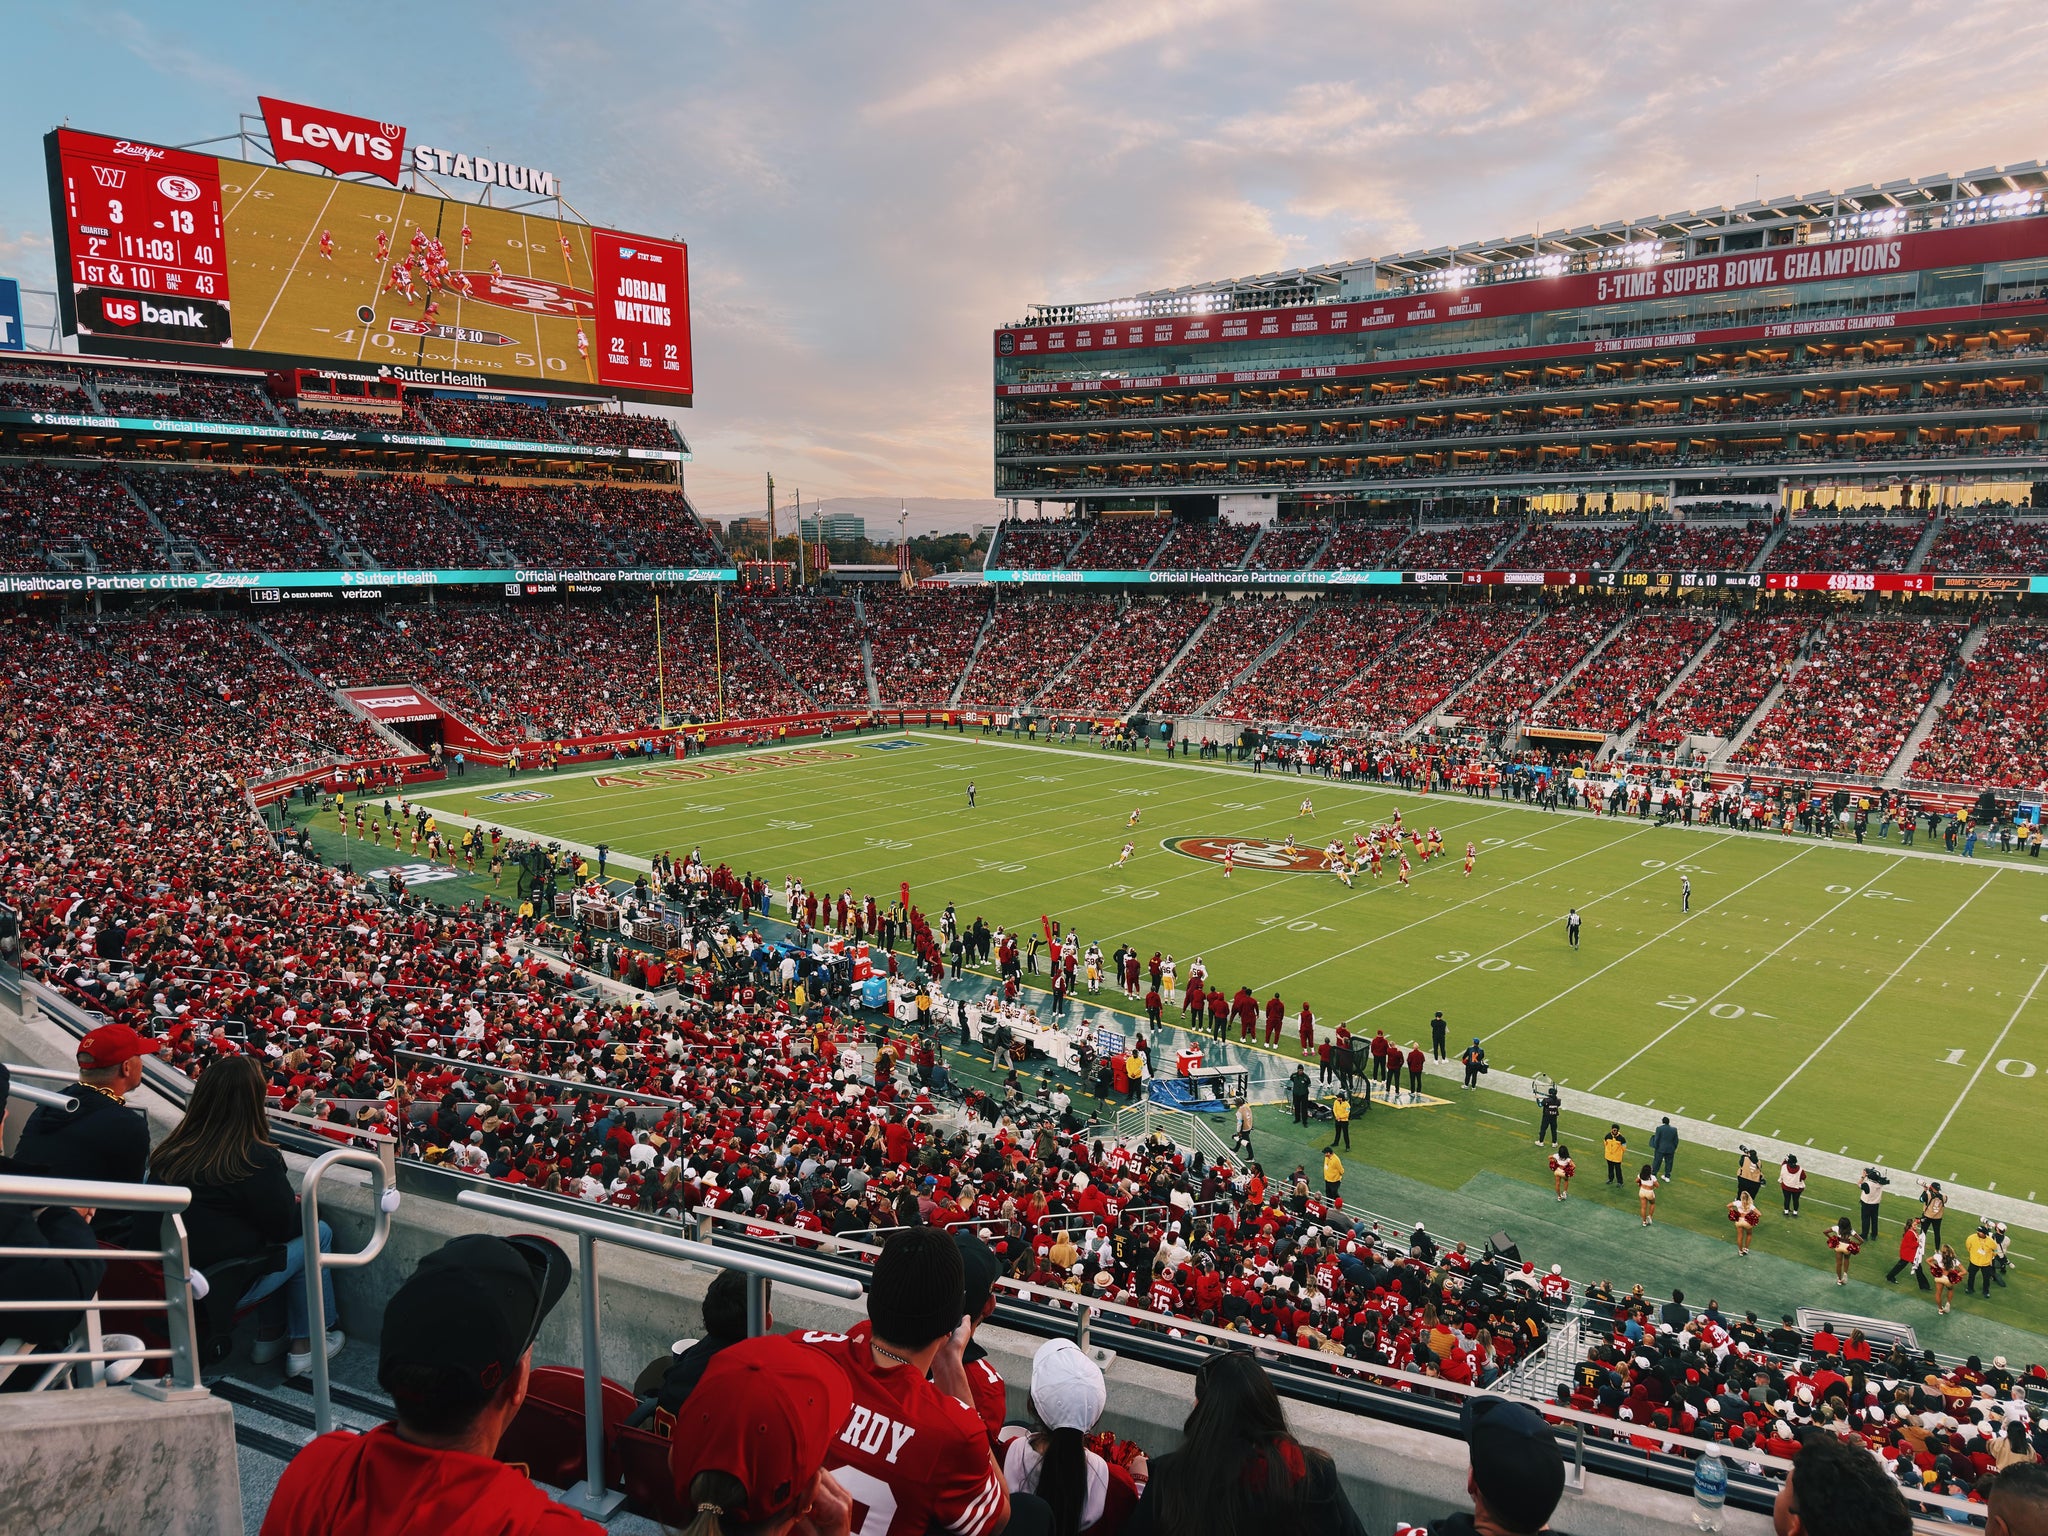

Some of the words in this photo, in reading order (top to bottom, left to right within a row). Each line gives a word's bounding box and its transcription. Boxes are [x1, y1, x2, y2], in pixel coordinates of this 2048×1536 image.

[281, 118, 393, 161] Levi's
[113, 141, 164, 161] Faithful
[415, 145, 553, 196] STADIUM
[109, 200, 123, 224] 3
[170, 209, 194, 234] 13
[81, 225, 109, 236] QUARTER
[125, 235, 174, 262] 11:03
[194, 246, 213, 265] 40
[79, 262, 105, 283] 1ST
[109, 265, 124, 286] &
[131, 267, 151, 287] 10
[1598, 273, 1657, 301] 5-TIME
[1662, 264, 1719, 295] SUPER
[1724, 257, 1778, 287] BOWL
[1784, 242, 1902, 280] CHAMPIONS
[166, 273, 182, 284] BALL
[167, 281, 179, 291] ON:
[195, 276, 214, 295] 43
[617, 277, 666, 303] JORDAN
[106, 301, 137, 321] us
[614, 300, 671, 327] WATKINS
[1407, 309, 1435, 321] MONTANA
[1448, 303, 1482, 316] NOMELLINI
[1260, 324, 1279, 334] JONES
[1331, 319, 1347, 329] LOTT
[1764, 324, 1792, 337] 8-TIME
[1793, 319, 1845, 335] CONFERENCE
[1847, 315, 1896, 330] CHAMPIONS
[458, 330, 467, 341] &
[469, 331, 483, 343] 10
[1155, 332, 1172, 341] HALEY
[1184, 329, 1210, 340] JOHNSON
[1221, 327, 1248, 337] JOHNSON
[611, 337, 625, 353] 22
[1103, 336, 1117, 345] DEAN
[1594, 338, 1622, 352] 22-TIME
[1622, 337, 1653, 350] DIVISION
[1654, 333, 1696, 348] CHAMPIONS
[642, 341, 648, 356] 1
[664, 344, 677, 359] 22
[412, 352, 503, 368] NOVARTIS
[608, 353, 629, 365] YARDS
[640, 357, 652, 368] REC
[663, 360, 680, 371] LONG
[349, 374, 380, 383] STADIUM
[394, 366, 439, 384] Sutter
[442, 370, 487, 387] Health
[1234, 372, 1255, 382] GEORGE
[1256, 370, 1281, 380] SEIFERT
[1301, 368, 1313, 378] BILL
[1315, 367, 1336, 377] WALSH
[1071, 383, 1084, 391] JOHN
[1120, 380, 1134, 388] TONY
[1179, 377, 1189, 385] VIC
[44, 414, 81, 426] Sutter
[83, 416, 120, 428] Health
[152, 420, 193, 432] Official
[195, 422, 251, 435] Healthcare
[253, 426, 289, 438] Partner
[290, 428, 301, 438] of
[302, 428, 319, 439] the
[391, 434, 420, 445] Sutter
[420, 436, 446, 447] Health
[470, 439, 499, 449] Official
[501, 441, 542, 452] Healthcare
[544, 443, 569, 454] Partner
[570, 444, 579, 454] of
[580, 445, 593, 455] the
[11, 576, 82, 591] Healthcare
[87, 575, 146, 590] Partner
[150, 575, 167, 588] of
[170, 574, 197, 587] the
[355, 572, 396, 585] Sutter
[397, 571, 437, 584] Health
[515, 570, 557, 582] Official
[559, 570, 616, 582] Healthcare
[619, 571, 654, 581] Partner
[656, 570, 667, 581] of
[668, 570, 685, 580] the
[1021, 572, 1051, 582] Sutter
[1052, 572, 1084, 582] Health
[1150, 572, 1188, 583] Official
[1190, 572, 1249, 583] Healthcare
[1251, 573, 1291, 583] Partner
[1293, 572, 1308, 583] of
[1309, 572, 1326, 583] the
[1427, 573, 1448, 581] bank
[1476, 574, 1482, 583] 3
[1504, 574, 1544, 583] COMMANDERS
[1569, 574, 1576, 584] 3
[1608, 574, 1615, 585] 2
[1623, 573, 1648, 585] 11:03
[1659, 576, 1669, 584] 40
[1681, 575, 1697, 586] 1ST
[1698, 577, 1704, 586] &
[1706, 575, 1717, 586] 10
[1748, 575, 1760, 586] 43
[1785, 576, 1798, 587] 13
[1827, 575, 1875, 590] 49ERS
[1916, 579, 1923, 589] 2
[1945, 578, 1966, 586] HOME
[342, 589, 382, 599] verizon
[538, 584, 557, 593] bank
[576, 584, 602, 593] NetApp
[407, 714, 437, 722] STADIUM
[1102, 884, 1161, 900] 50
[1255, 915, 1319, 932] 40
[1435, 950, 1511, 972] 30
[1656, 994, 1745, 1020] 20
[1935, 1048, 2037, 1079] 10
[1316, 1272, 1332, 1289] 85
[1546, 1286, 1563, 1299] 54
[1153, 1293, 1171, 1310] 16
[840, 1403, 915, 1463] RDY
